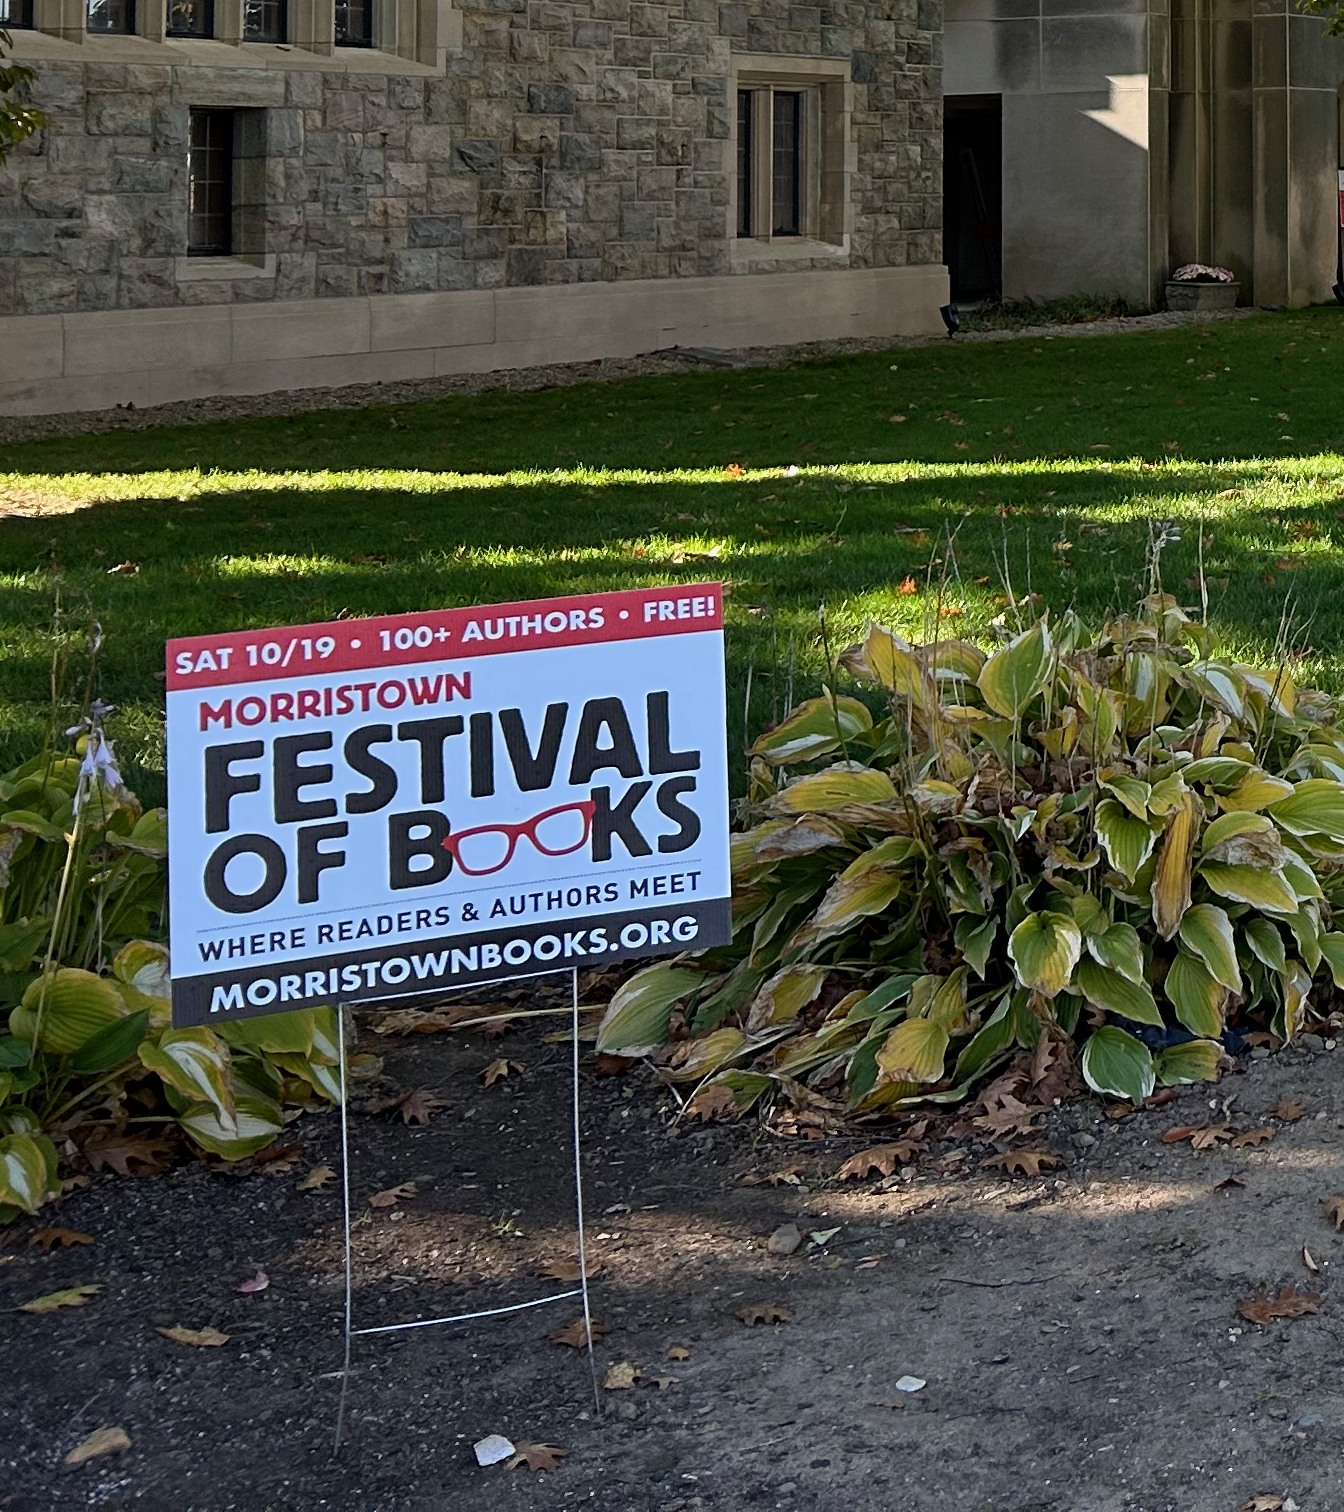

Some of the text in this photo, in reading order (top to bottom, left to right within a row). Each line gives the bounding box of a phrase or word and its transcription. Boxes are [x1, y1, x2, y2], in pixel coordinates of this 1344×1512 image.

[176, 595, 717, 676] SAT 10/19 100+ AUTHORS FREE!
[199, 671, 472, 731] MORRISTOWN
[205, 690, 701, 834] FESTIVAL
[204, 821, 348, 914] OF
[198, 872, 702, 962] WHERE READERS & AUTHORS MEET
[210, 916, 698, 1013] MORRISTOWNBOOKS.ORG
